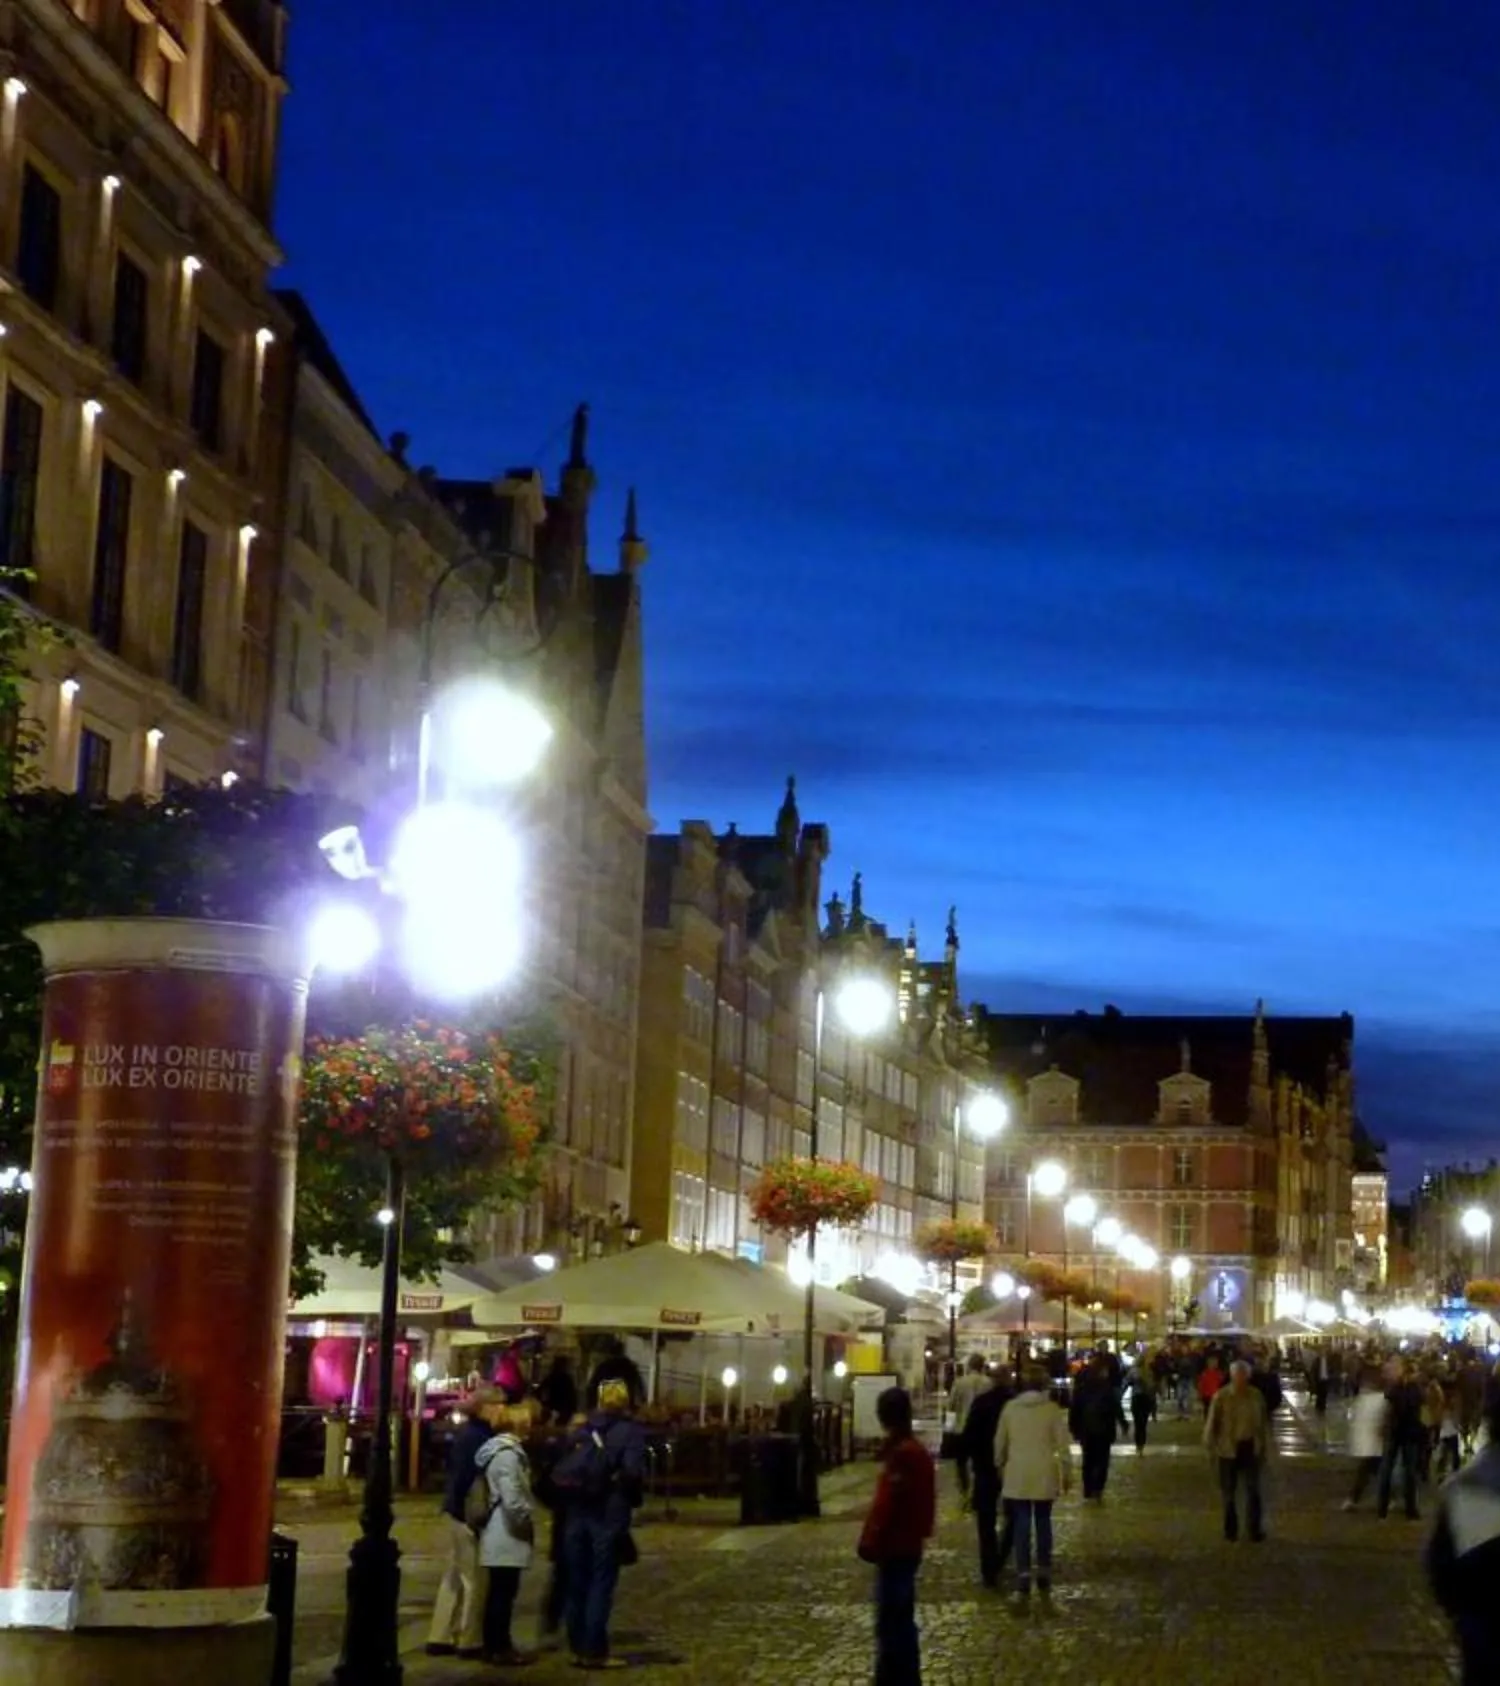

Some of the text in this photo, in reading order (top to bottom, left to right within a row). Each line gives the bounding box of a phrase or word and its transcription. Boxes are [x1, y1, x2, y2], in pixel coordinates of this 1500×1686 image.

[83, 1046, 262, 1073] LUX IN ORIENTE
[82, 1067, 259, 1096] LUX EX ORIENTE
